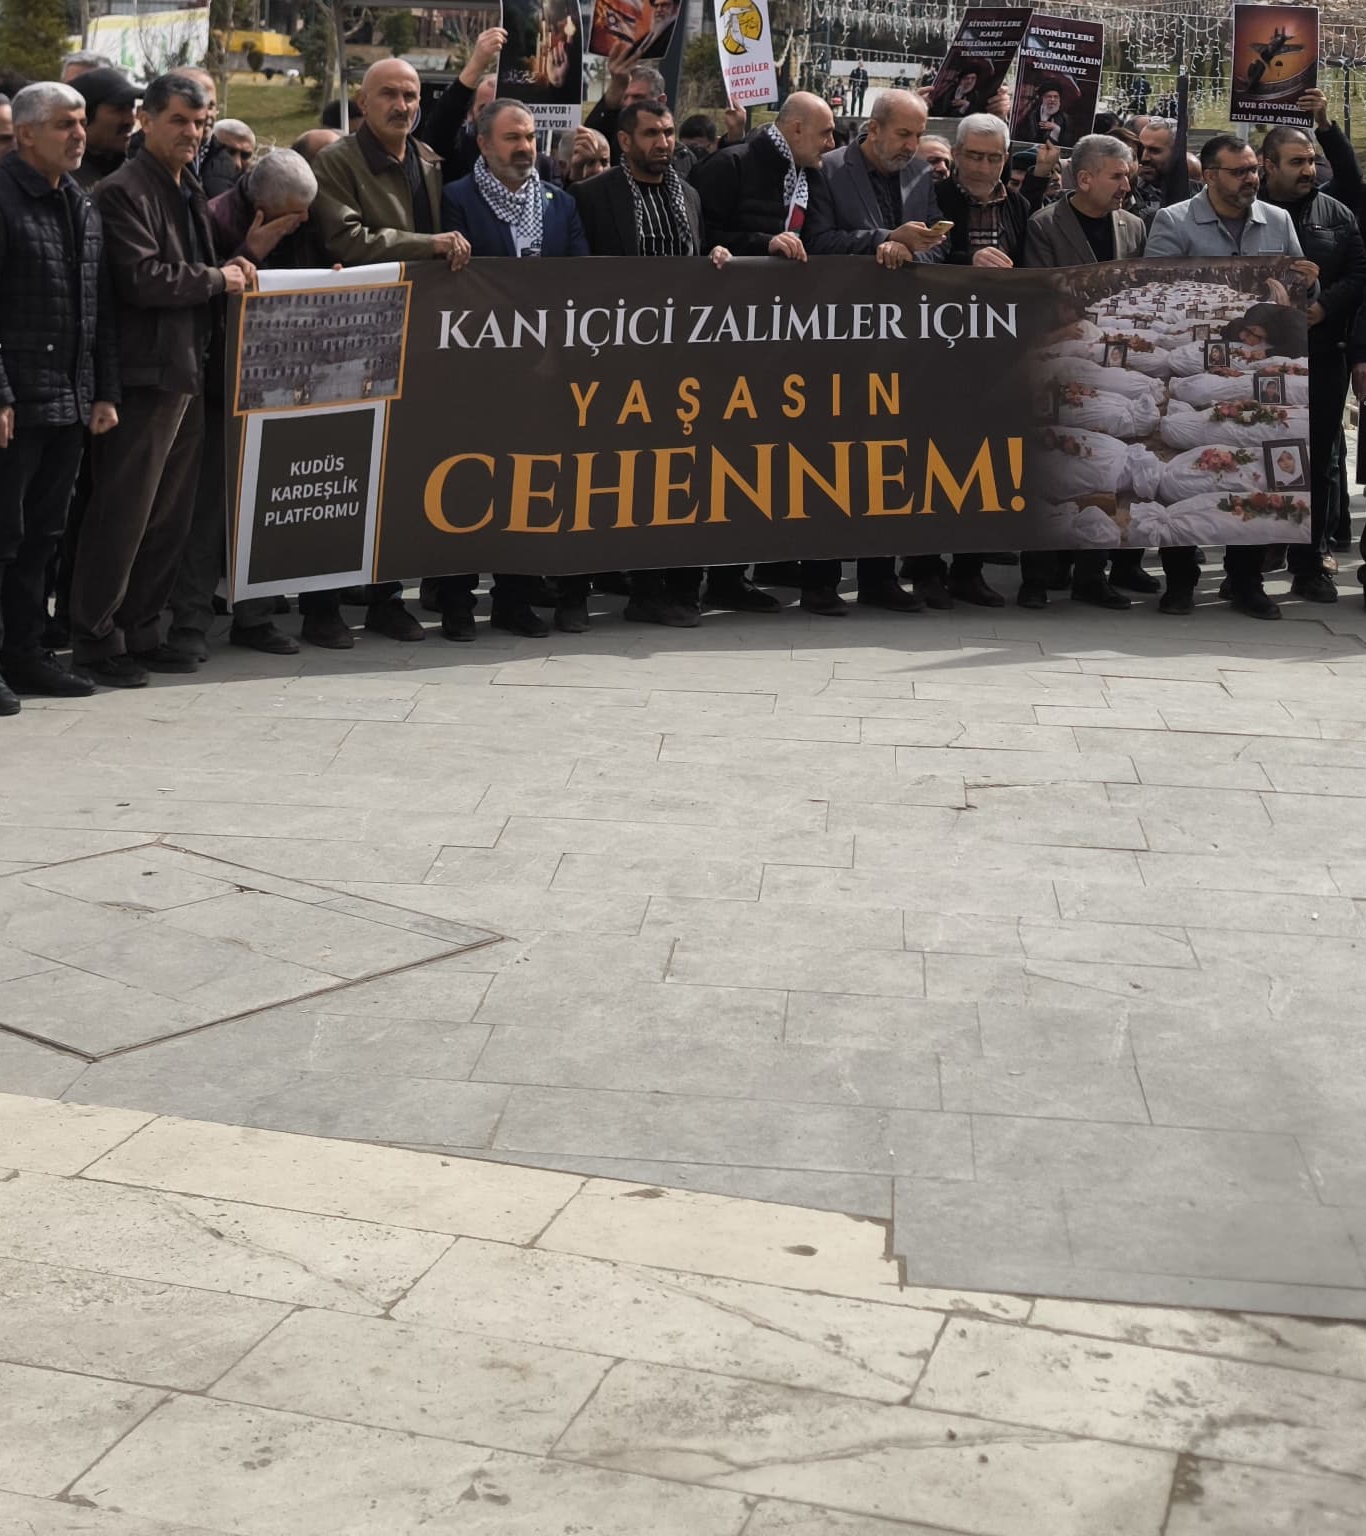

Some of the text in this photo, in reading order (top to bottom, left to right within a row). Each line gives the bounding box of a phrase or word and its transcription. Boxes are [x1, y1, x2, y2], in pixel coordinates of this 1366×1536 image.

[967, 19, 1023, 28] SİYONİSTLERE
[1030, 27, 1095, 42] SİYONİSTLERE
[1048, 41, 1076, 51] KARŞI
[1021, 49, 1101, 66] MÜSLÜMANLARIN
[1033, 62, 1087, 75] YANINDAYIZ
[731, 76, 756, 88] YATAY
[530, 105, 547, 114] RAN
[549, 105, 567, 114] VUR
[1238, 101, 1256, 109] VUR
[549, 119, 567, 128] VUR
[436, 294, 1020, 356] KAN İÇİCİ ZALİMLER İÇİN
[570, 372, 902, 436] YAŞASIN
[290, 455, 345, 476] KUDÜS
[271, 475, 359, 502] KARDEŞLİK
[423, 436, 1026, 534] CEHENNEM!
[264, 501, 360, 527] PLATFORMU
